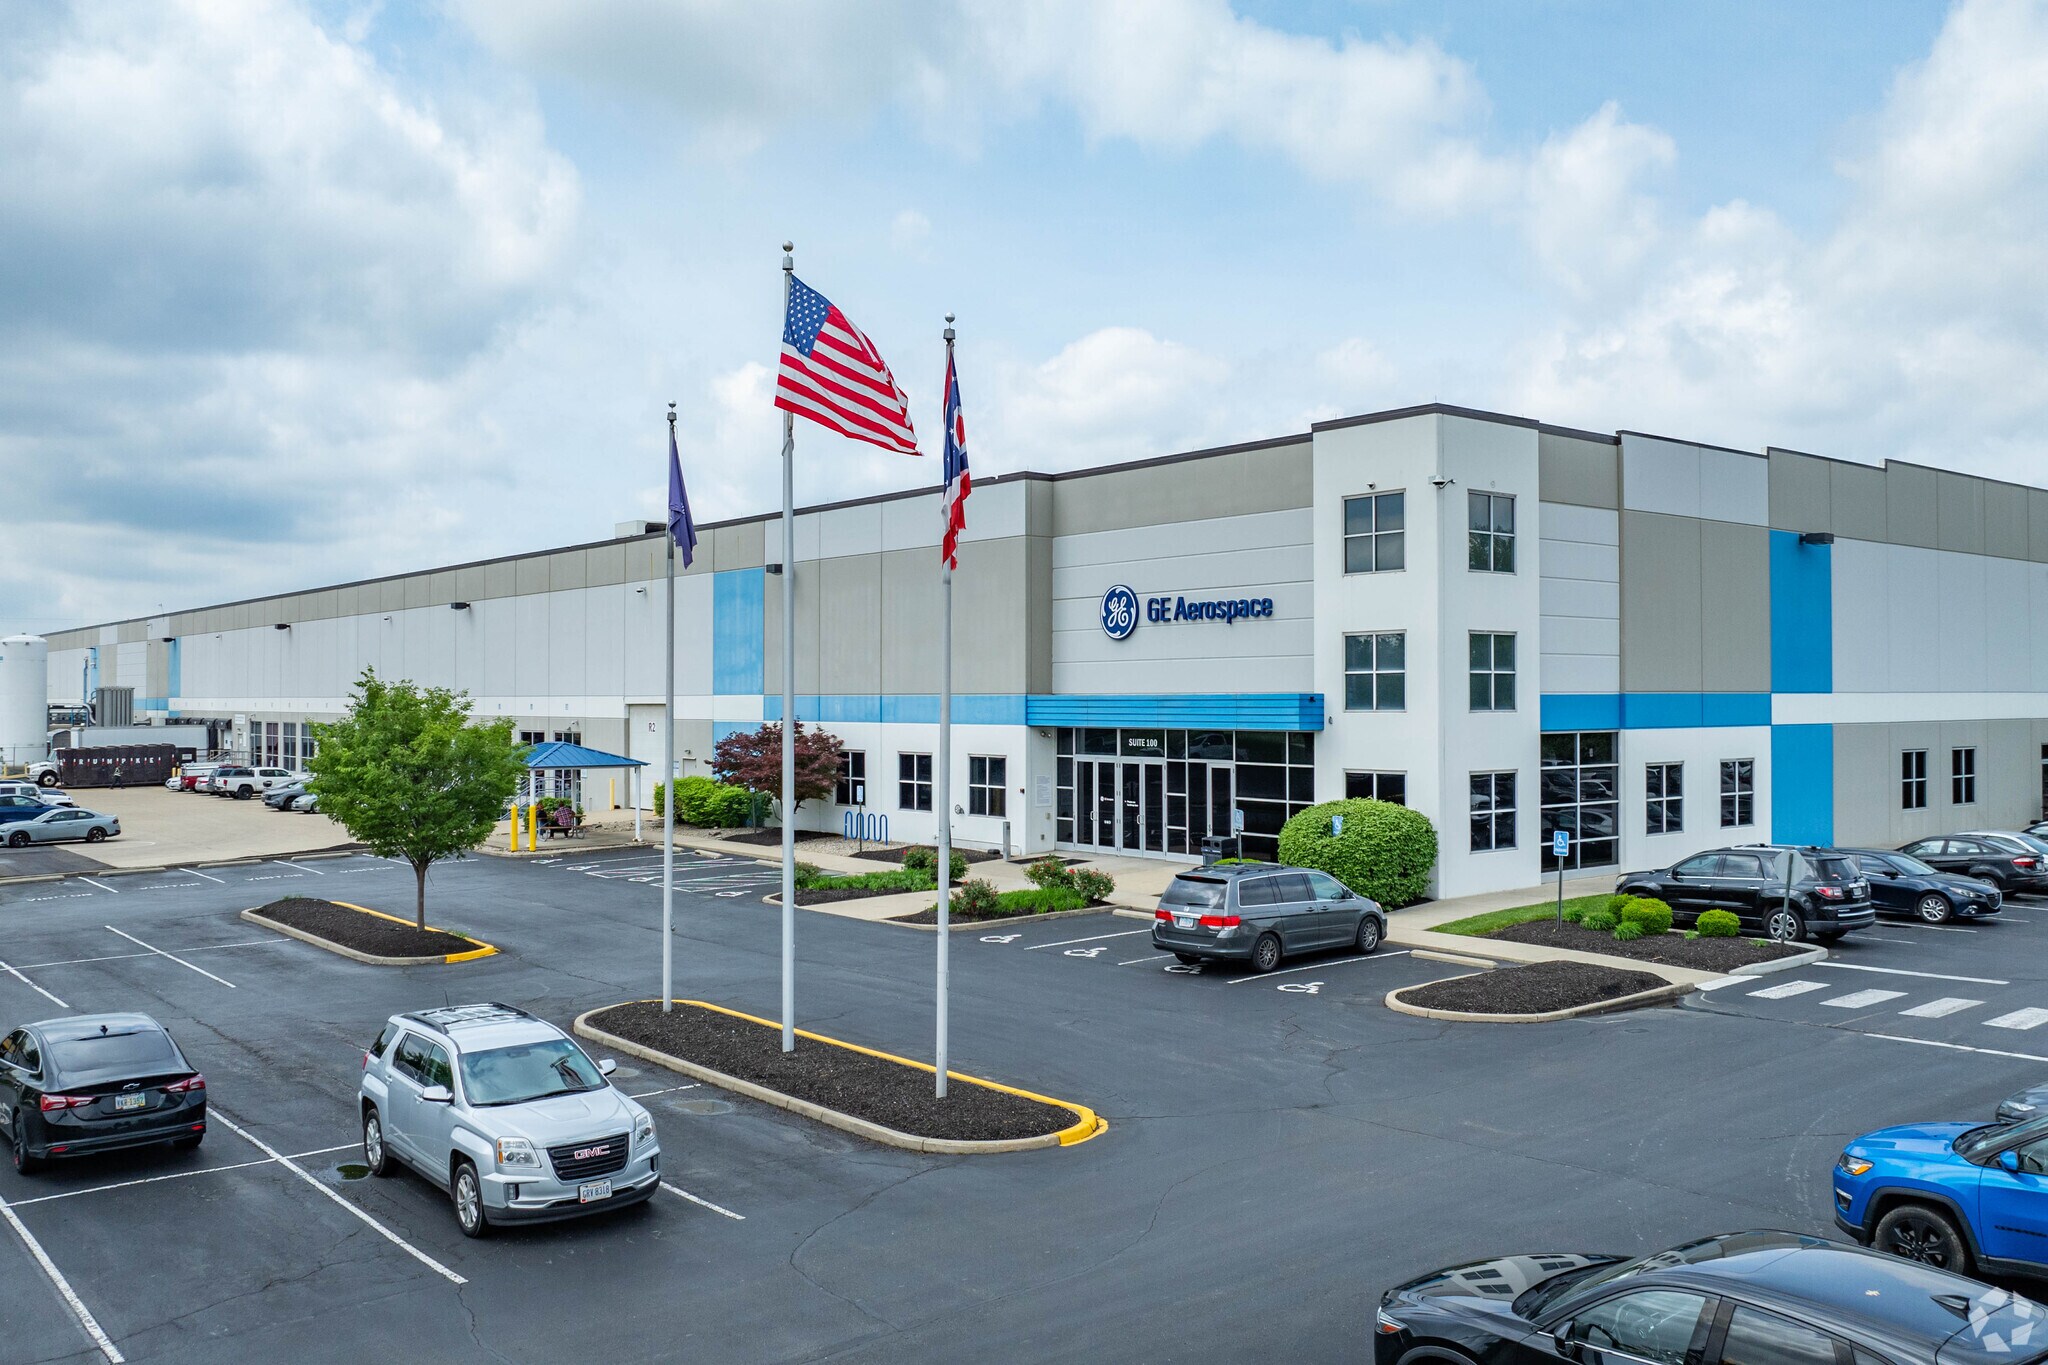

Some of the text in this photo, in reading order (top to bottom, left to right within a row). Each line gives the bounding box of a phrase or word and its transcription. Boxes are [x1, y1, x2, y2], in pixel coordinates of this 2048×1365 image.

[1147, 596, 1273, 625] GE Aerospace
[648, 722, 656, 733] R2
[1128, 738, 1158, 747] SUITE 100
[574, 1144, 610, 1160] GMC
